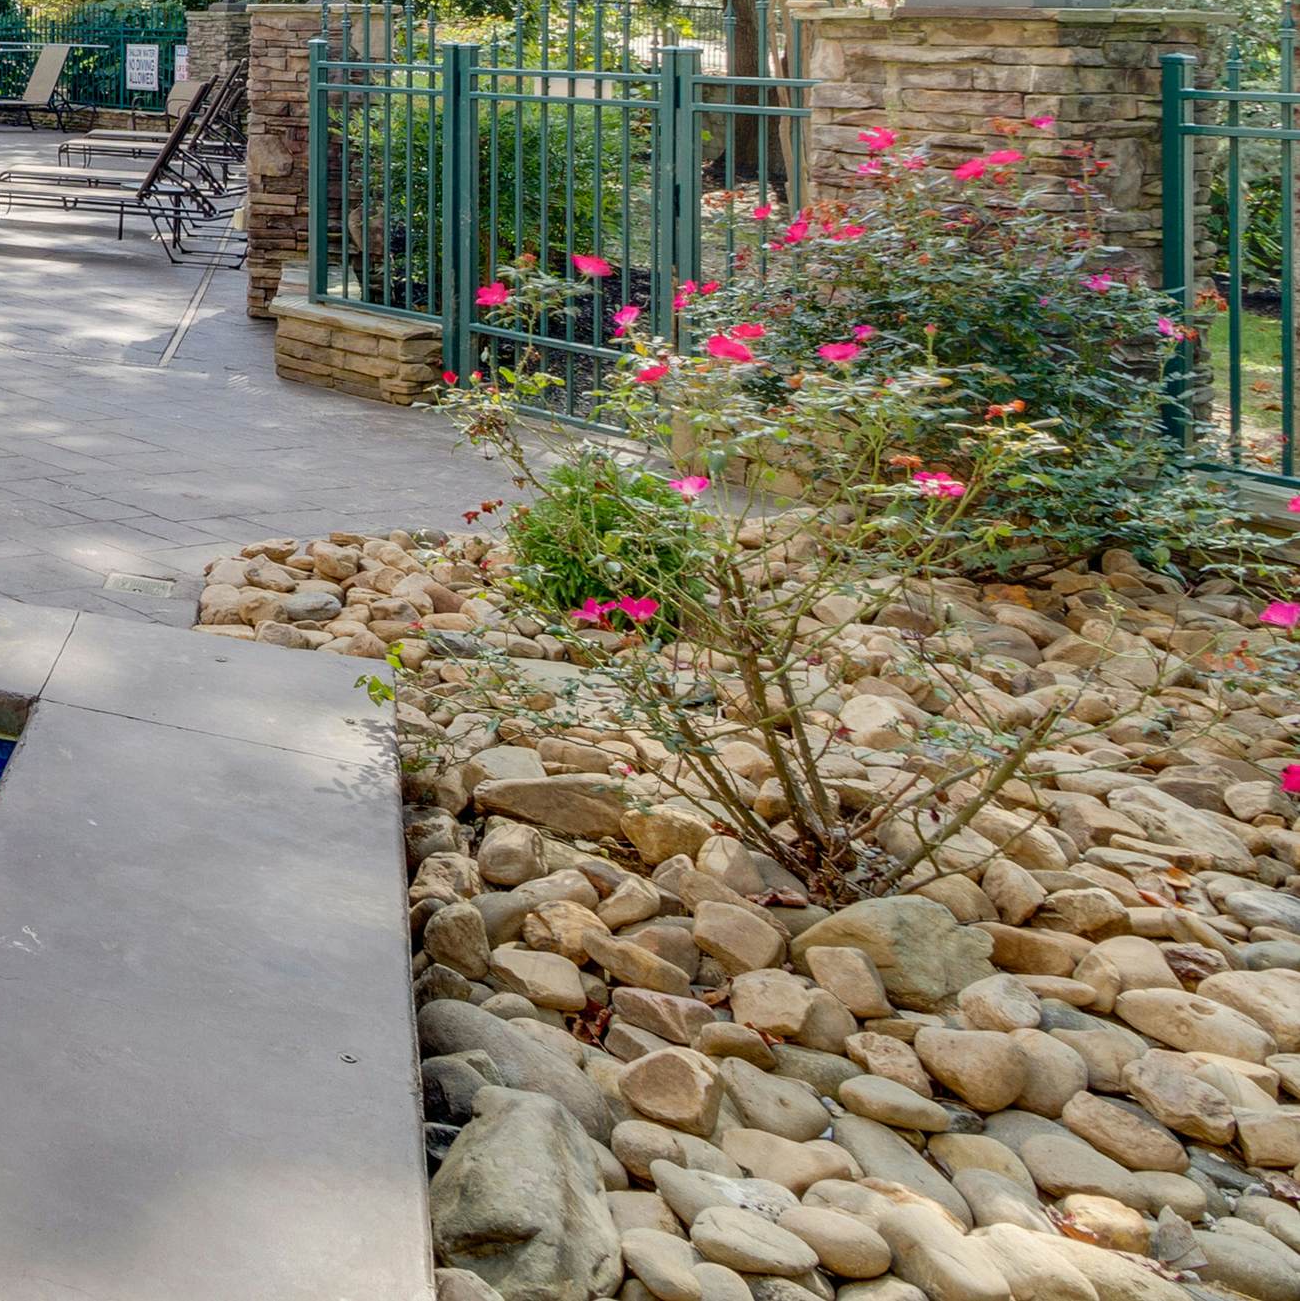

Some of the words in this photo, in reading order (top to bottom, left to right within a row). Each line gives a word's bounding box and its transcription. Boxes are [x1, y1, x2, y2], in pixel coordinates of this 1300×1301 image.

[143, 49, 155, 57] WATER
[129, 59, 135, 71] NO
[136, 60, 155, 71] DIVING
[129, 73, 154, 85] ALLOWED
